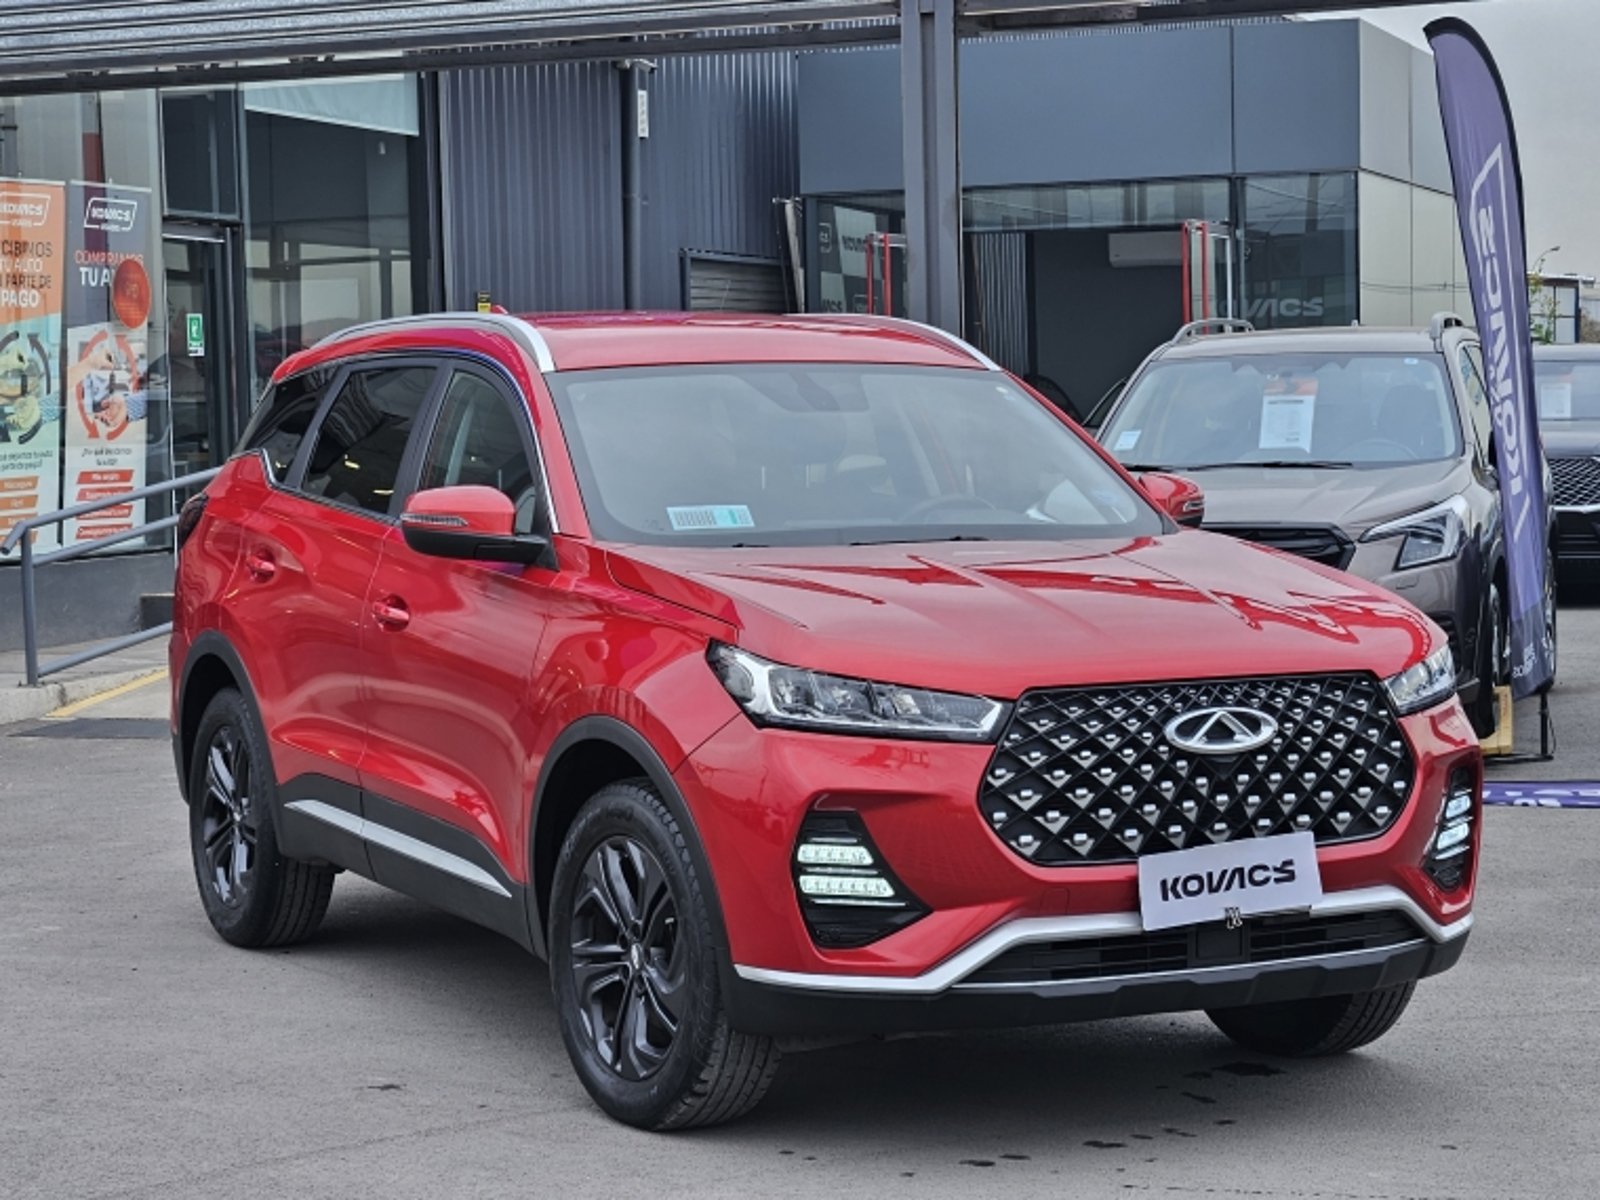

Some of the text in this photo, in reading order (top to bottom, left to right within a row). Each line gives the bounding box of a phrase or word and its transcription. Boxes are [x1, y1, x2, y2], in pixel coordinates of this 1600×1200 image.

[1, 239, 53, 258] CIBIMOS
[79, 266, 98, 288] TU
[1, 288, 40, 308] PAGO
[1219, 296, 1325, 318] OVACS
[1159, 858, 1297, 902] KOVACS
